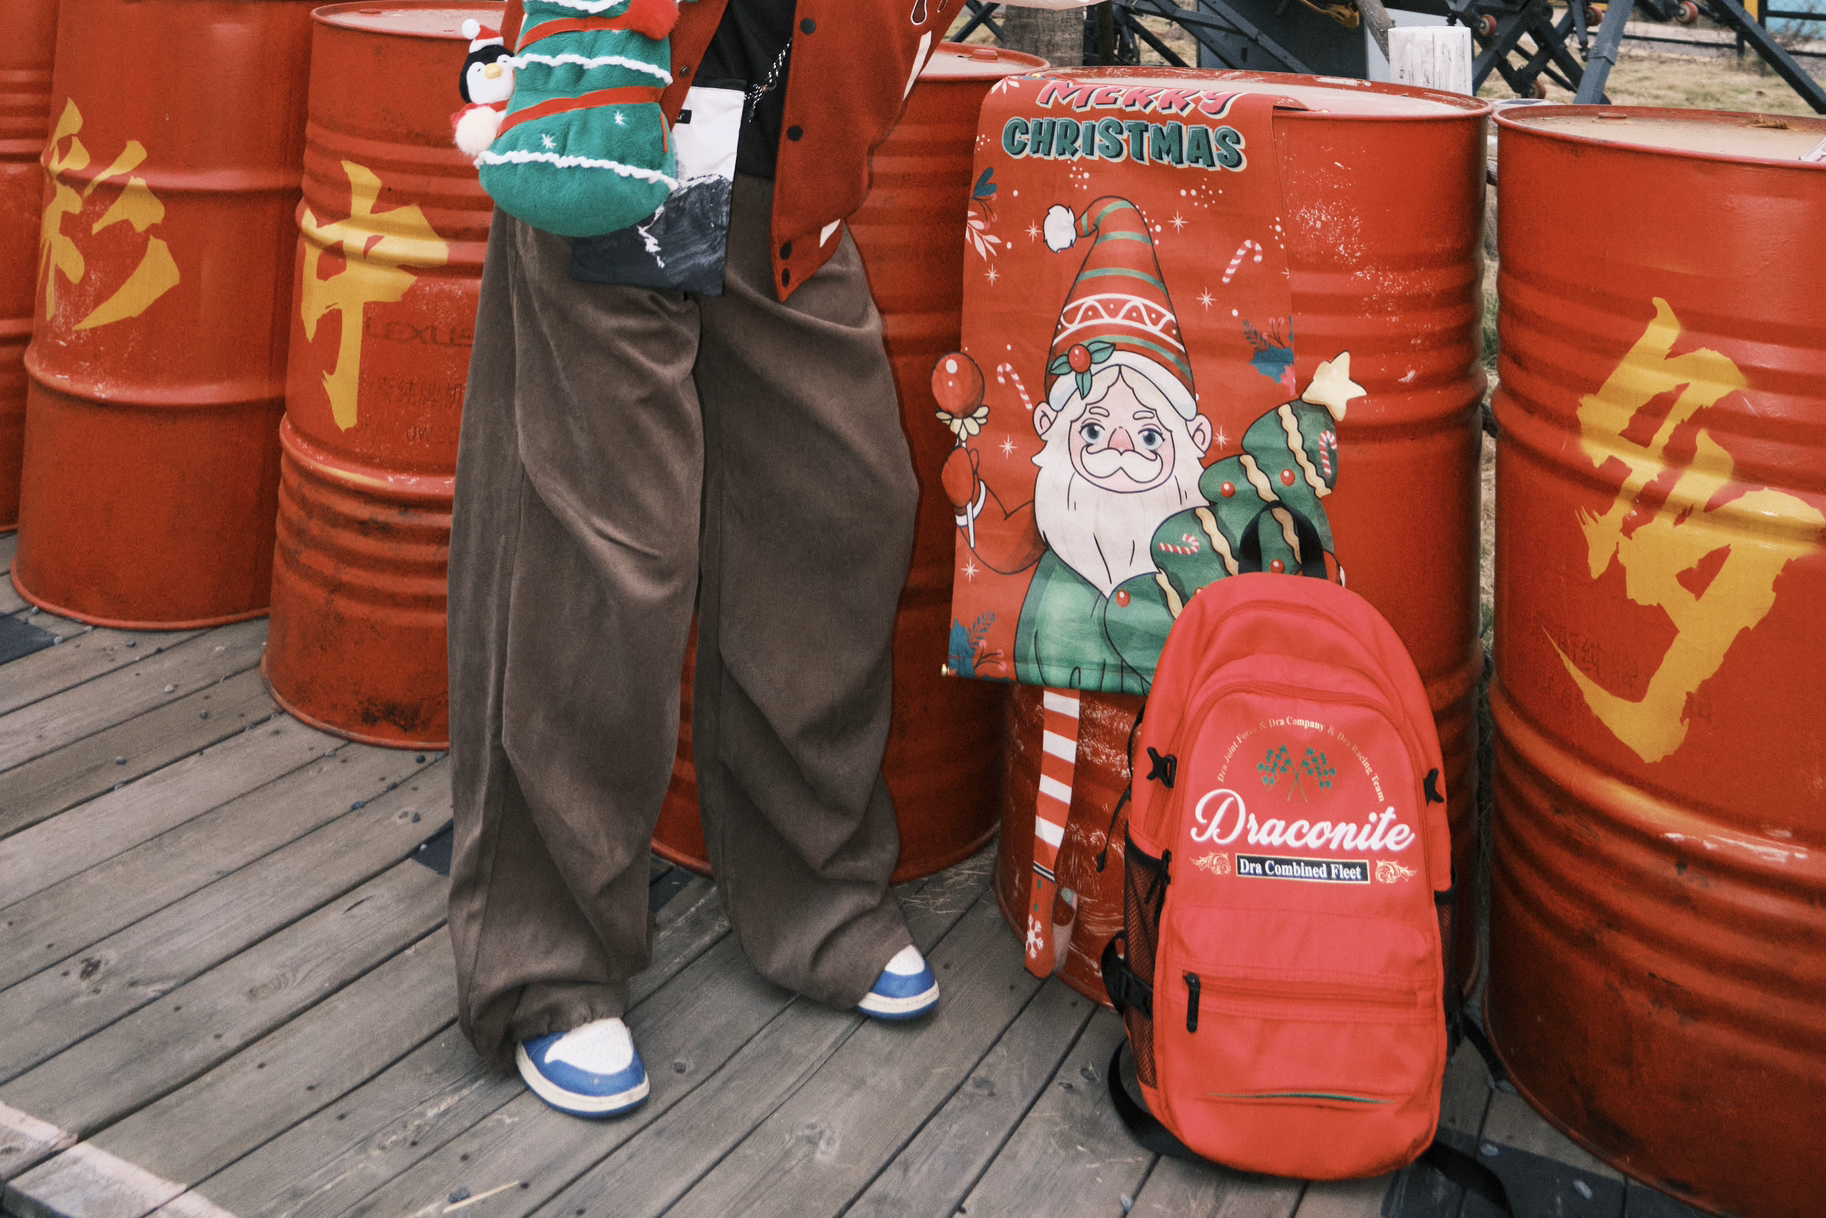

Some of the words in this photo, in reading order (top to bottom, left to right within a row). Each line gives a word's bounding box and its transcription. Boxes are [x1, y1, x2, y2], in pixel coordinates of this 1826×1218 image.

[1036, 81, 1250, 119] MERRY
[1002, 116, 1247, 173] CHRISTMAS
[1269, 718, 1285, 728] Dra
[1286, 716, 1325, 732] Company
[1351, 744, 1373, 776] Racing
[1371, 772, 1385, 802] Team
[1189, 787, 1416, 852] Draconite
[1239, 858, 1262, 875] Dra
[1265, 860, 1328, 879] Combined
[1330, 863, 1363, 880] Fleet
